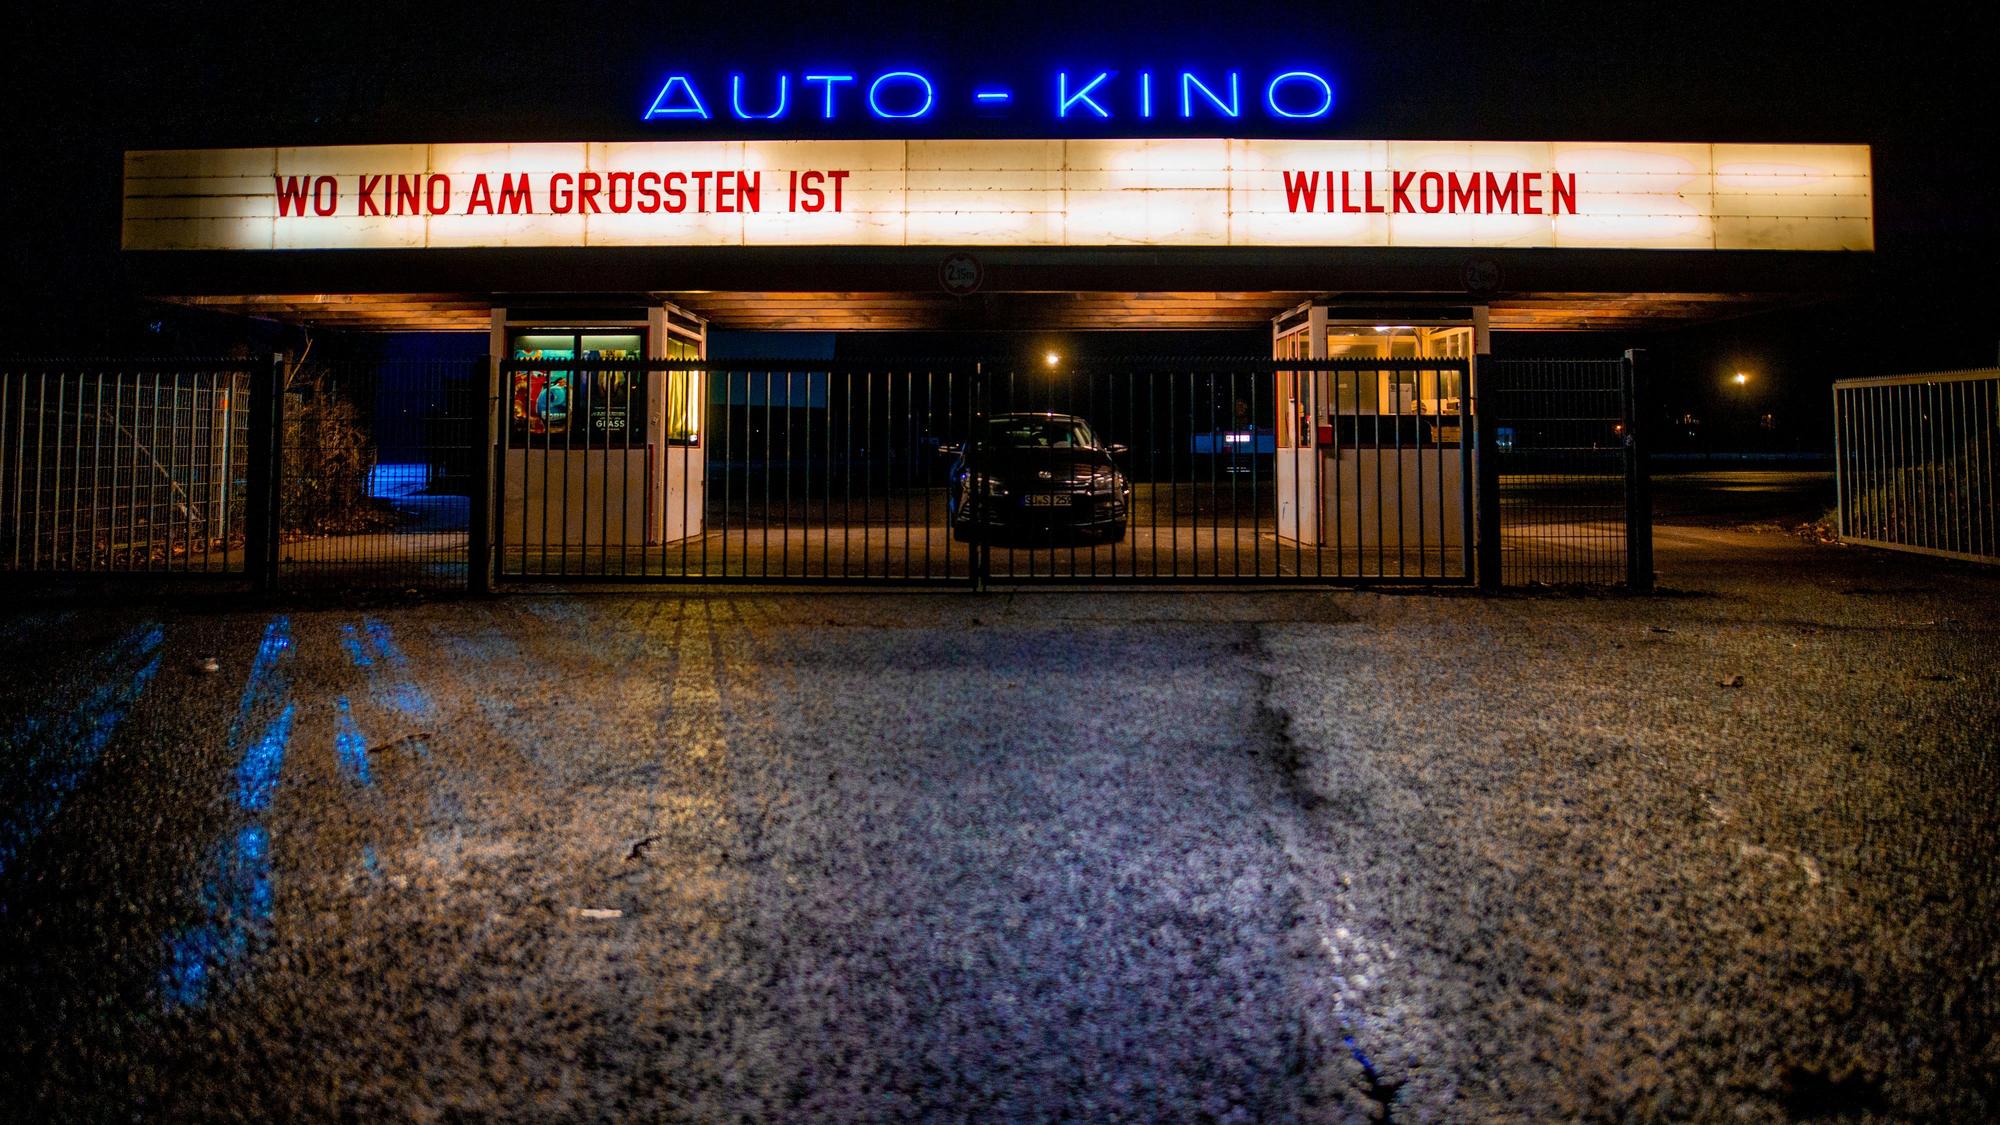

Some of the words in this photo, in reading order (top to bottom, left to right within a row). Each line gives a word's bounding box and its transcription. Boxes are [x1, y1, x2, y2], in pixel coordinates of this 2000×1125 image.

[645, 72, 932, 119] AUTO
[1059, 71, 1332, 118] KINO
[276, 175, 338, 217] WO
[358, 174, 450, 216] KINO
[466, 173, 533, 215] AM
[550, 170, 761, 214] GRÖSSTEN
[789, 170, 850, 213] IST
[1283, 170, 1577, 215] WILLKOMMEN
